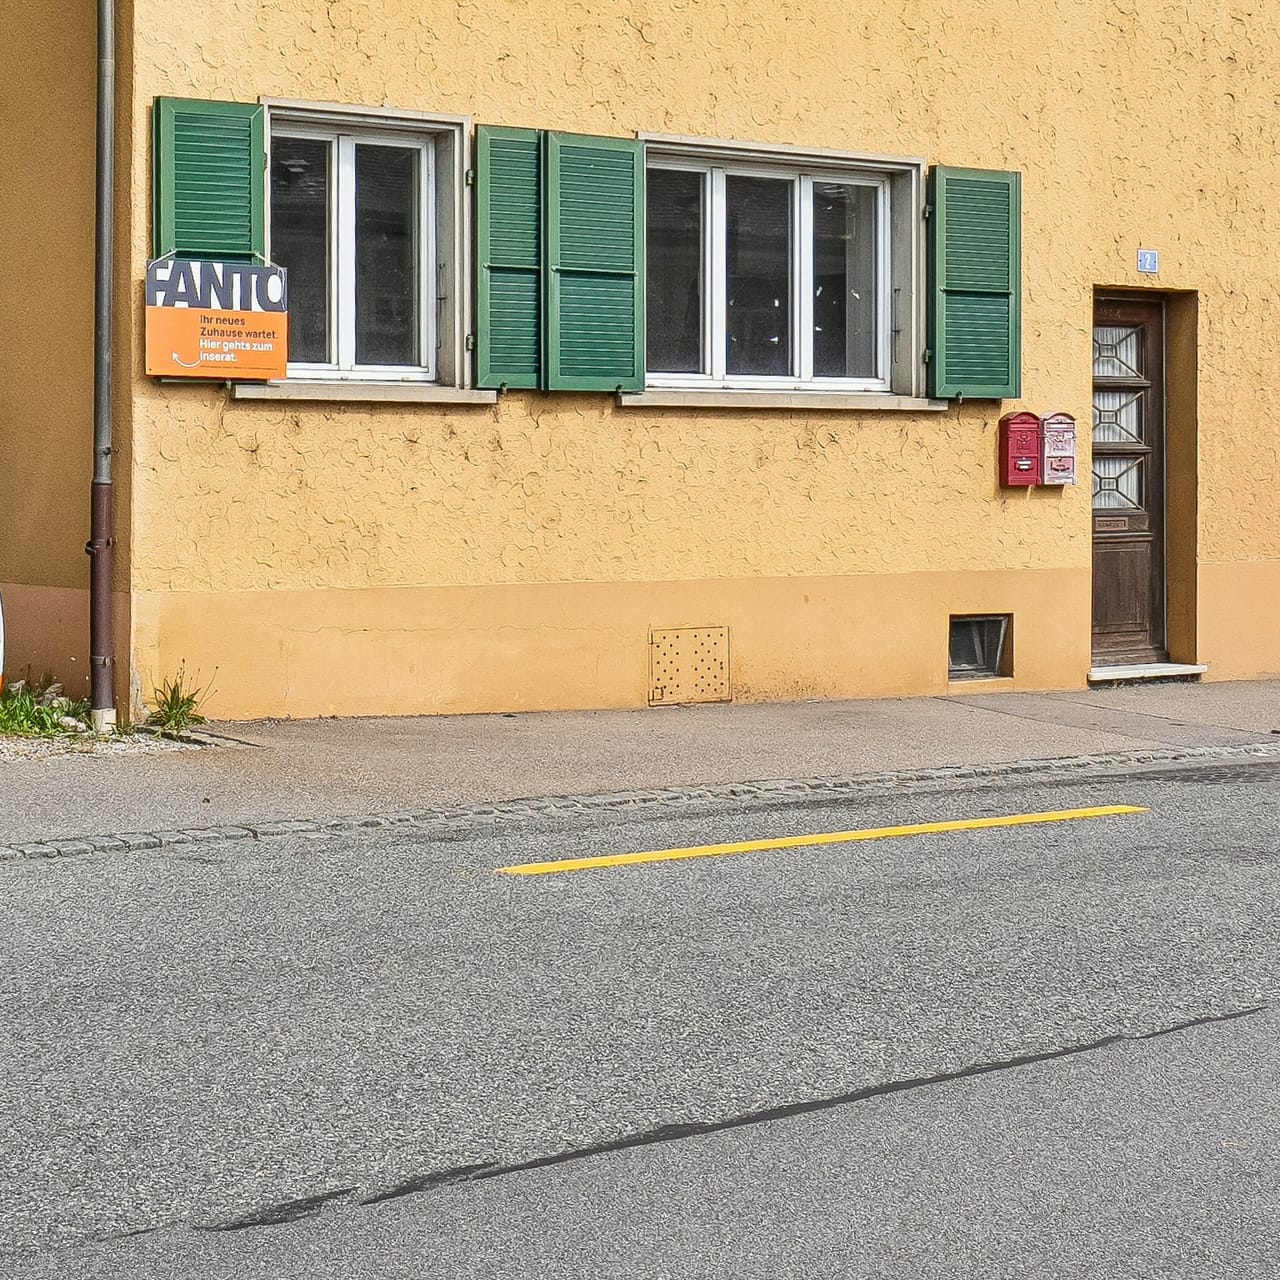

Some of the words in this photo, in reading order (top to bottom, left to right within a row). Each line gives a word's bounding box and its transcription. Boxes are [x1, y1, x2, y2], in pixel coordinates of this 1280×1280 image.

[1145, 253, 1151, 269] 2
[146, 259, 287, 312] FANTO
[200, 314, 214, 325] Ihr
[215, 317, 246, 326] neues
[200, 327, 243, 338] Zuhause
[245, 330, 280, 340] wartet.
[200, 339, 221, 349] Hier
[222, 340, 251, 352] gehts
[252, 343, 273, 351] zum
[200, 352, 238, 363] Inserat.
